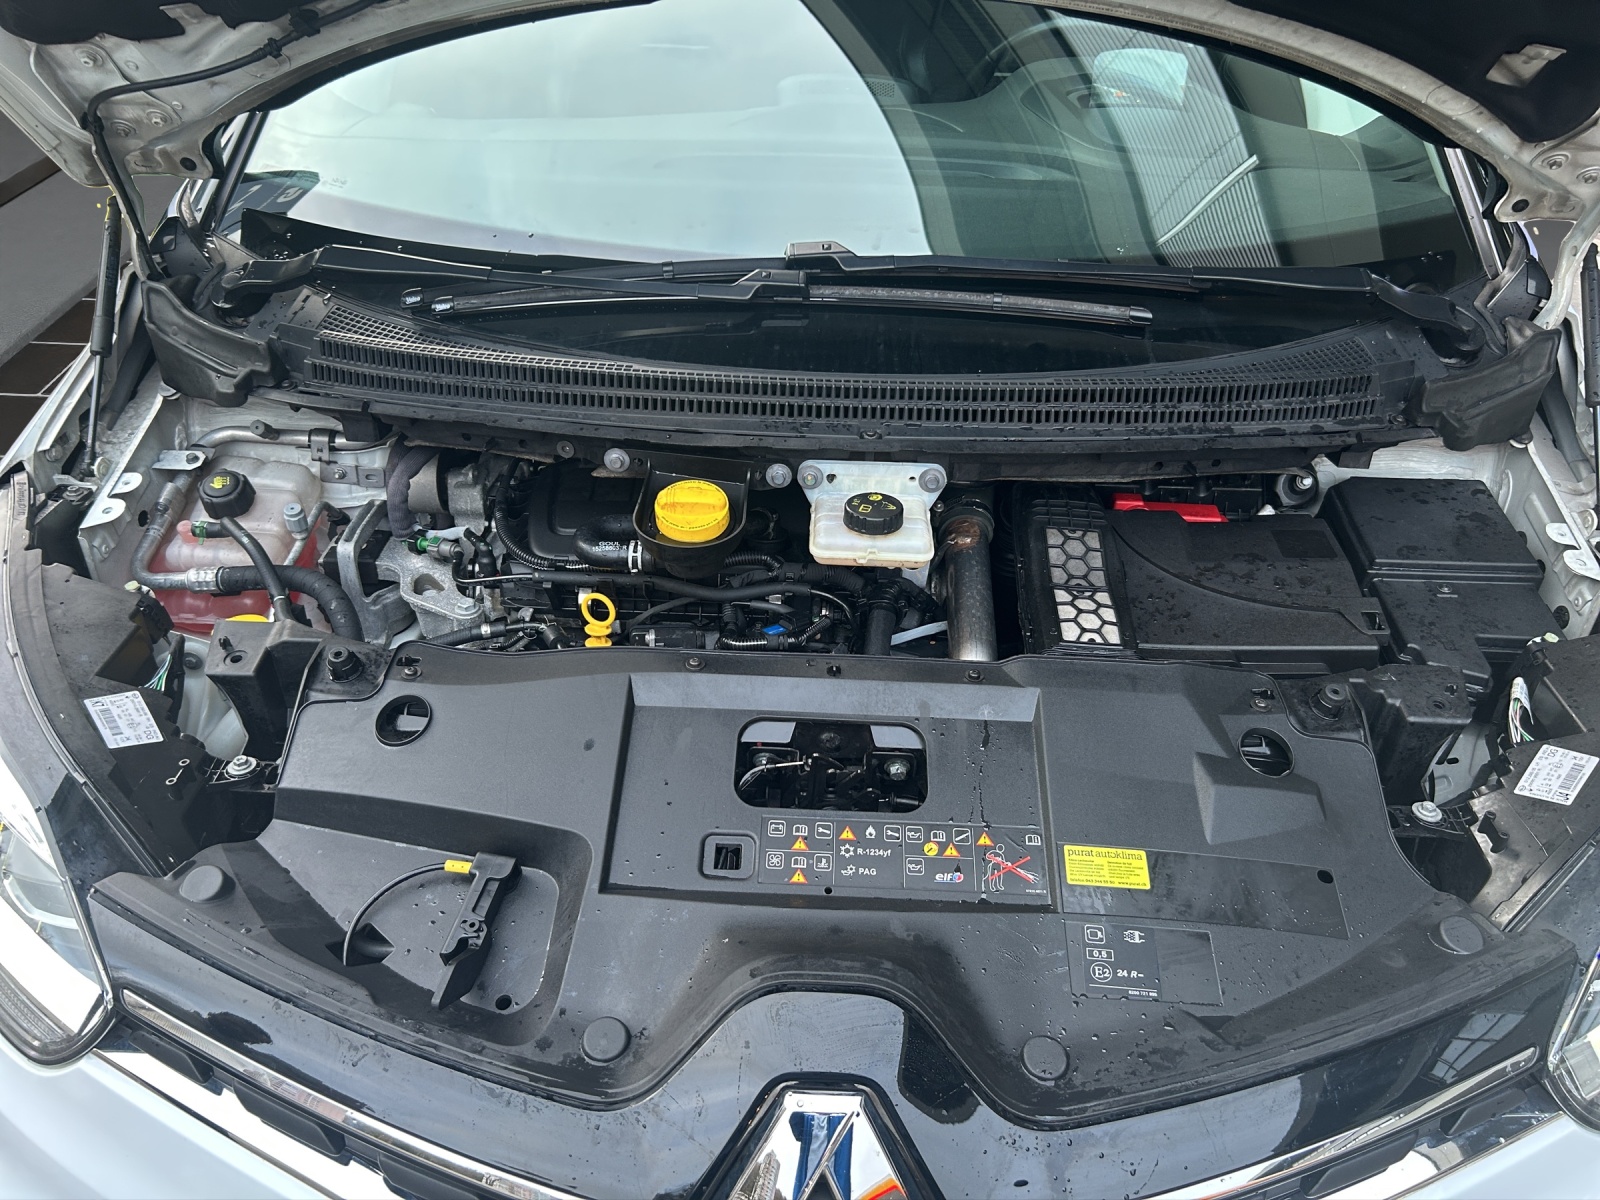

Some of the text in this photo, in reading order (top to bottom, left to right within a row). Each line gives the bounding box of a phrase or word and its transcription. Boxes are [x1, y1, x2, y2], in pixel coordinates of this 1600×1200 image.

[857, 847, 892, 858] R-1234yf
[1067, 848, 1094, 857] purat
[858, 867, 877, 876] PAG
[1116, 969, 1128, 978] 24
